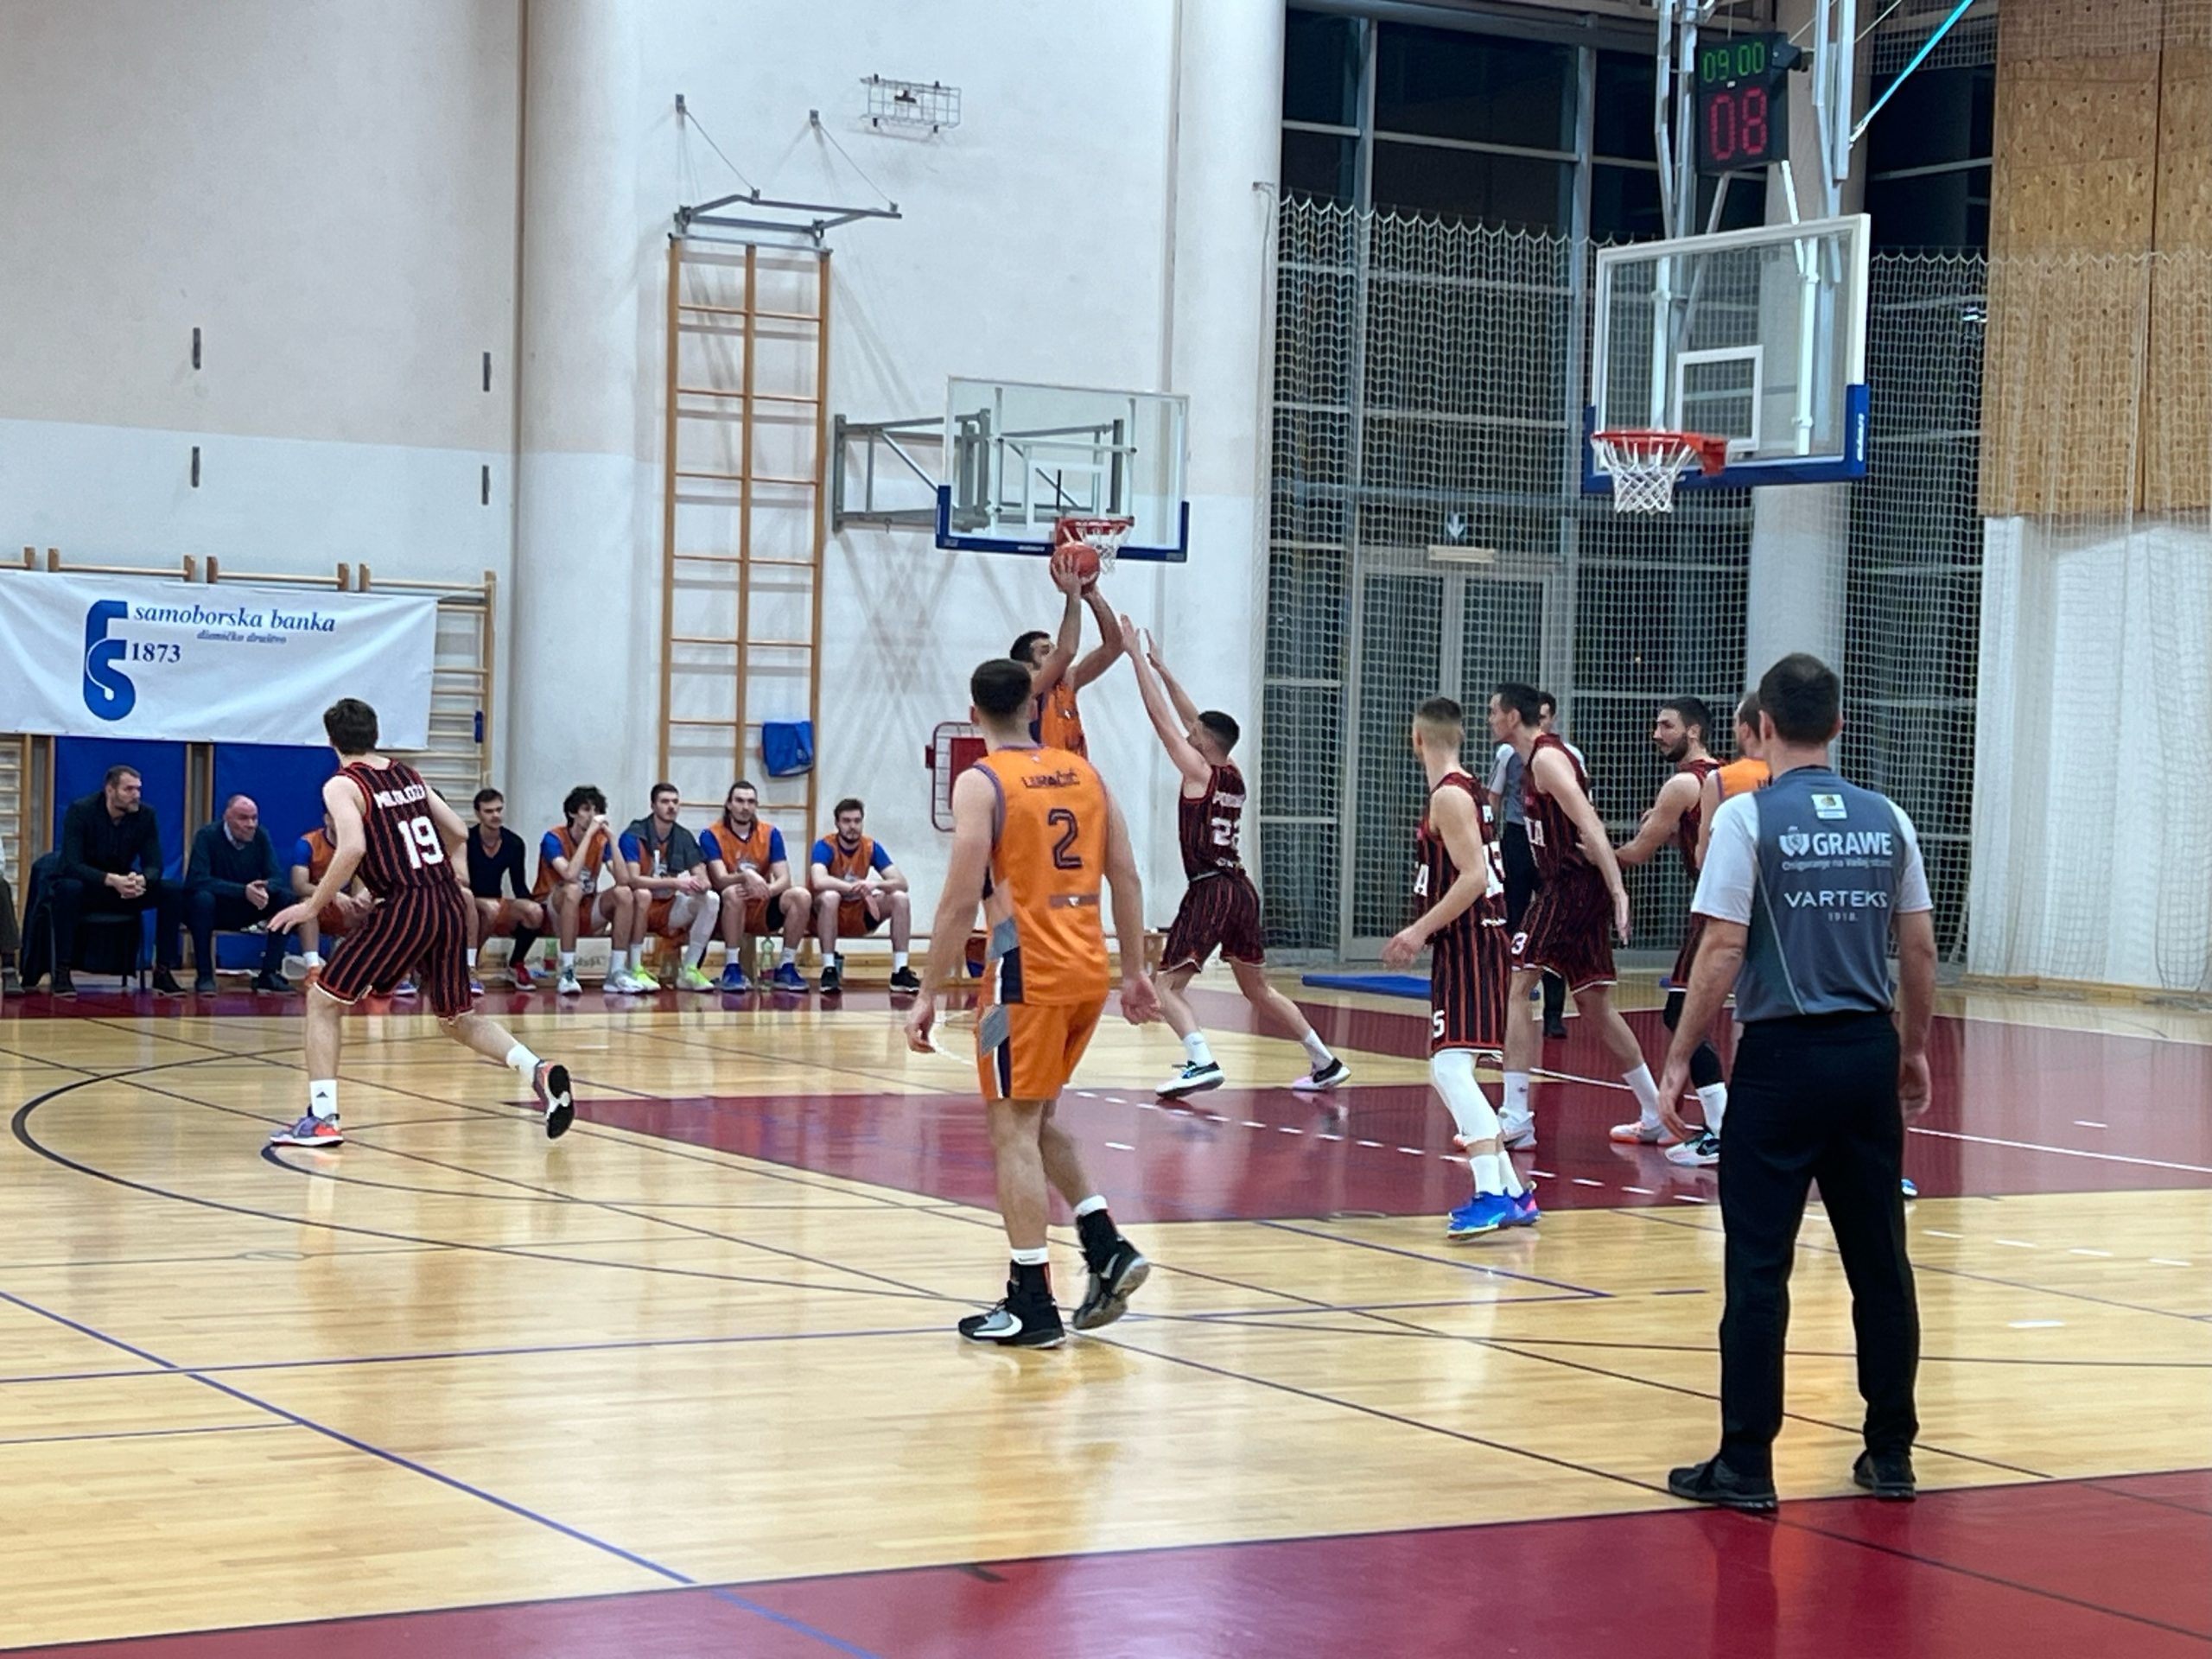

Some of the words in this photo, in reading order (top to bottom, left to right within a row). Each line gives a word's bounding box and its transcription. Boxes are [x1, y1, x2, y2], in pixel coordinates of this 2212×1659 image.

[1710, 87, 1768, 161] 08
[133, 604, 264, 629] samoborska
[271, 608, 336, 632] banka
[130, 642, 181, 664] 1873
[397, 815, 444, 869] 19
[1047, 808, 1083, 870] 2
[1812, 831, 1893, 856] GRAWE
[1783, 890, 1888, 909] VARTEKS
[1433, 1009, 1446, 1039] 5
